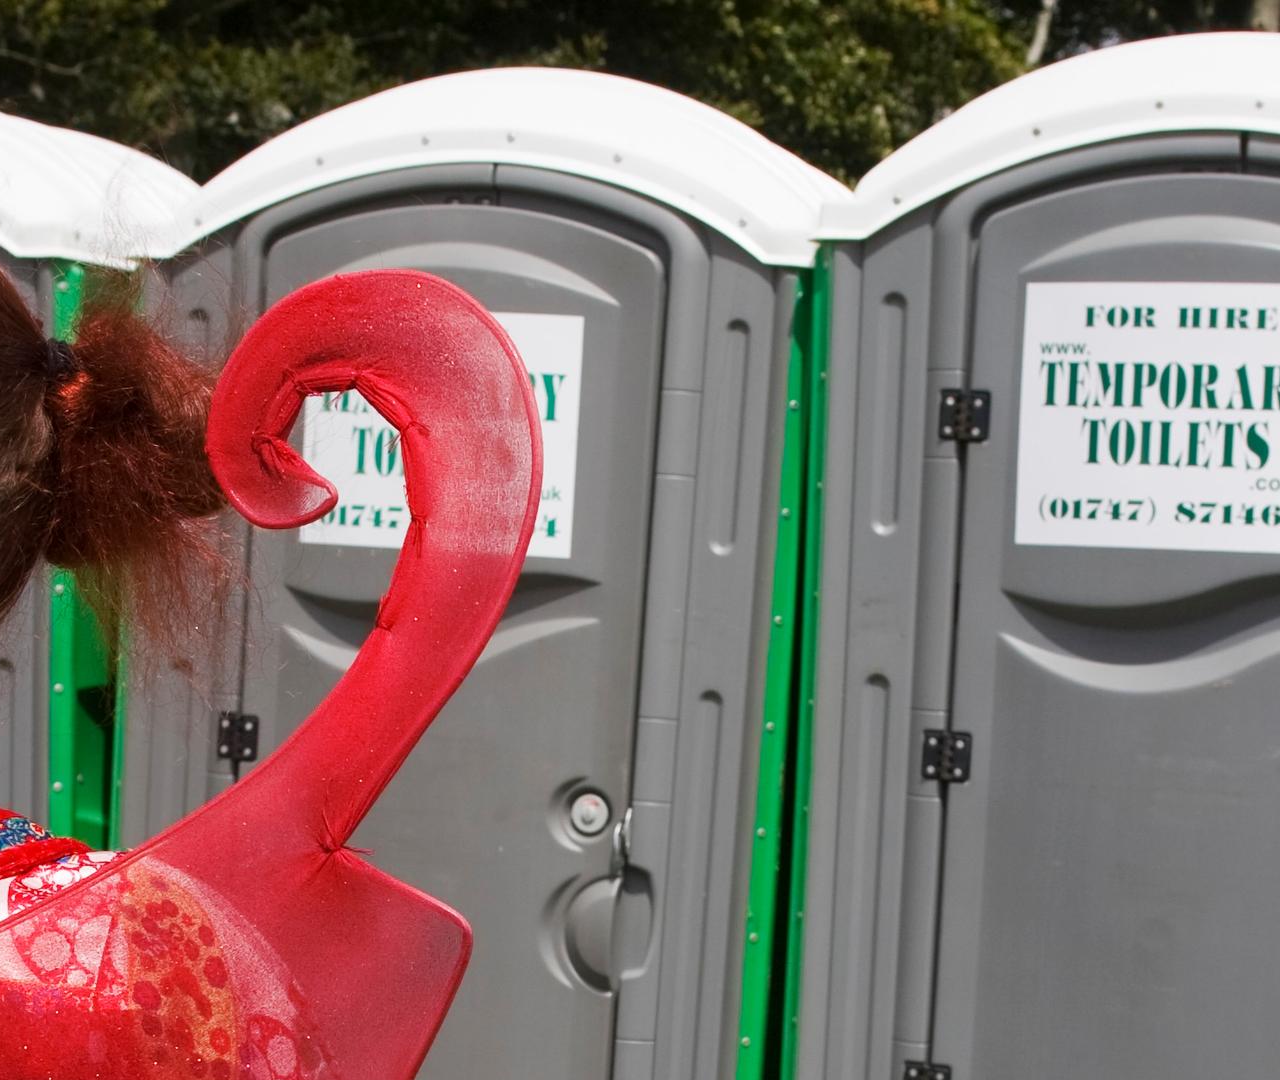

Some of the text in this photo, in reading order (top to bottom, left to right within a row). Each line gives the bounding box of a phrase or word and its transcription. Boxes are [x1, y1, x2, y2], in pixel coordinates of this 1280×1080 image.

[1085, 306, 1278, 331] FOR HIRE
[1040, 342, 1091, 355] www.
[1082, 418, 1270, 470] TOILETS
[320, 505, 403, 528] 01747
[1039, 495, 1156, 524] (01747)
